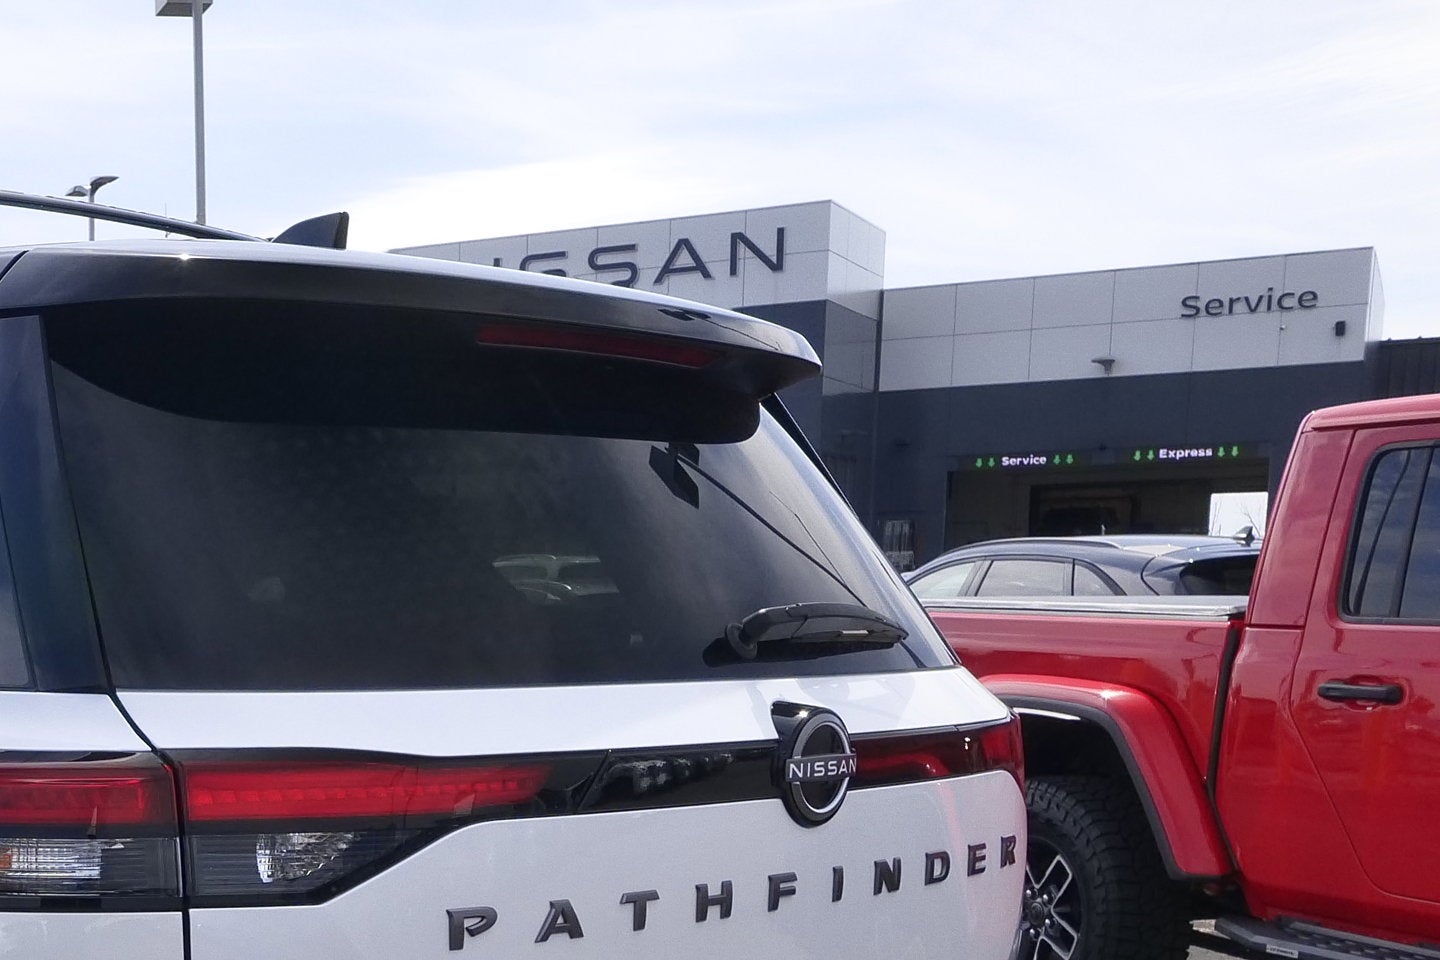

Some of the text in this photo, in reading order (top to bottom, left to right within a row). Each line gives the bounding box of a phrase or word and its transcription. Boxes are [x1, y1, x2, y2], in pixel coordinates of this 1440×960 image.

[1180, 287, 1319, 318] Service
[1001, 454, 1047, 467] Service
[1158, 447, 1213, 461] Express
[789, 758, 857, 779] NISSAN
[445, 834, 1017, 952] PATHFINDER
